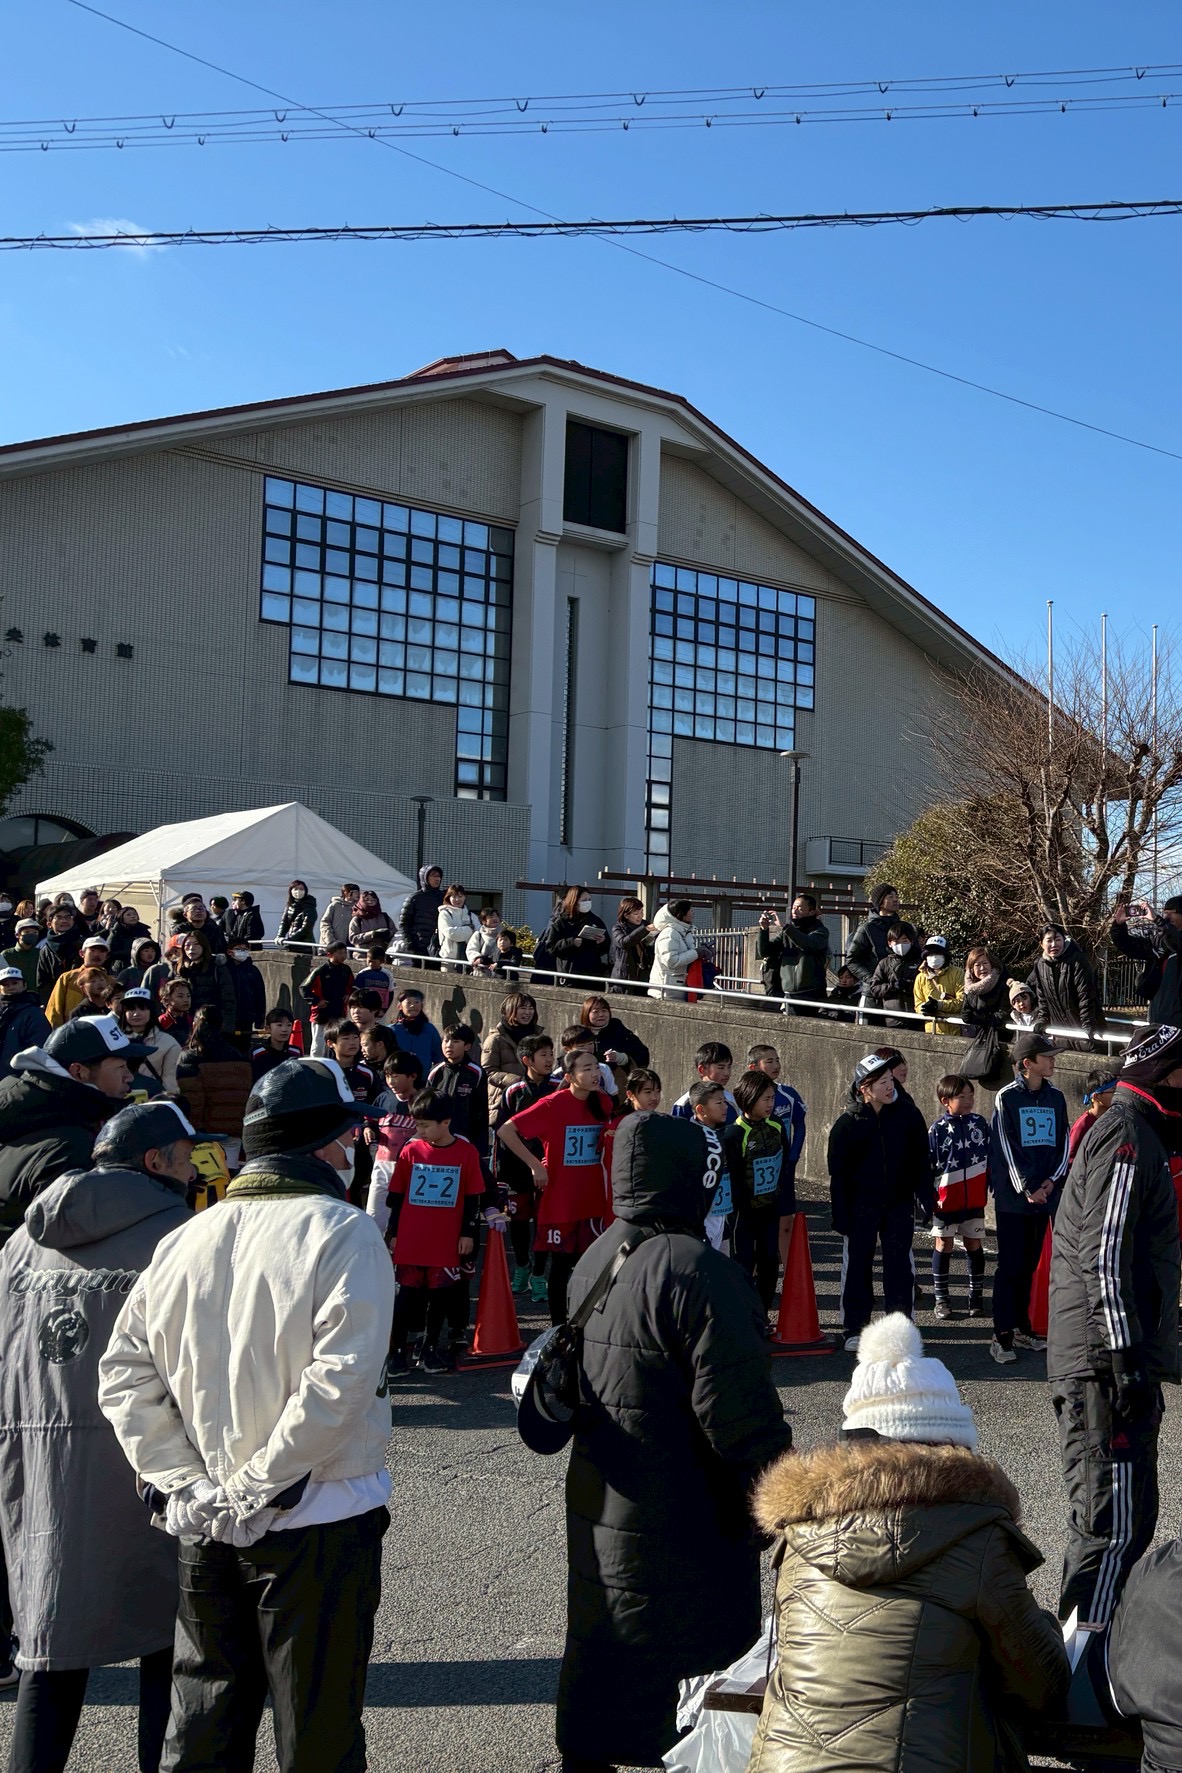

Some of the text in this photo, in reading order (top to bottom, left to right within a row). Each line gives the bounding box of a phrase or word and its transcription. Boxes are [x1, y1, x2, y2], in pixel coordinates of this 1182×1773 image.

[1138, 1042, 1160, 1059] Era
[1025, 1116, 1054, 1137] 9-2
[415, 1175, 454, 1198] 2-2
[547, 1228, 562, 1245] 16
